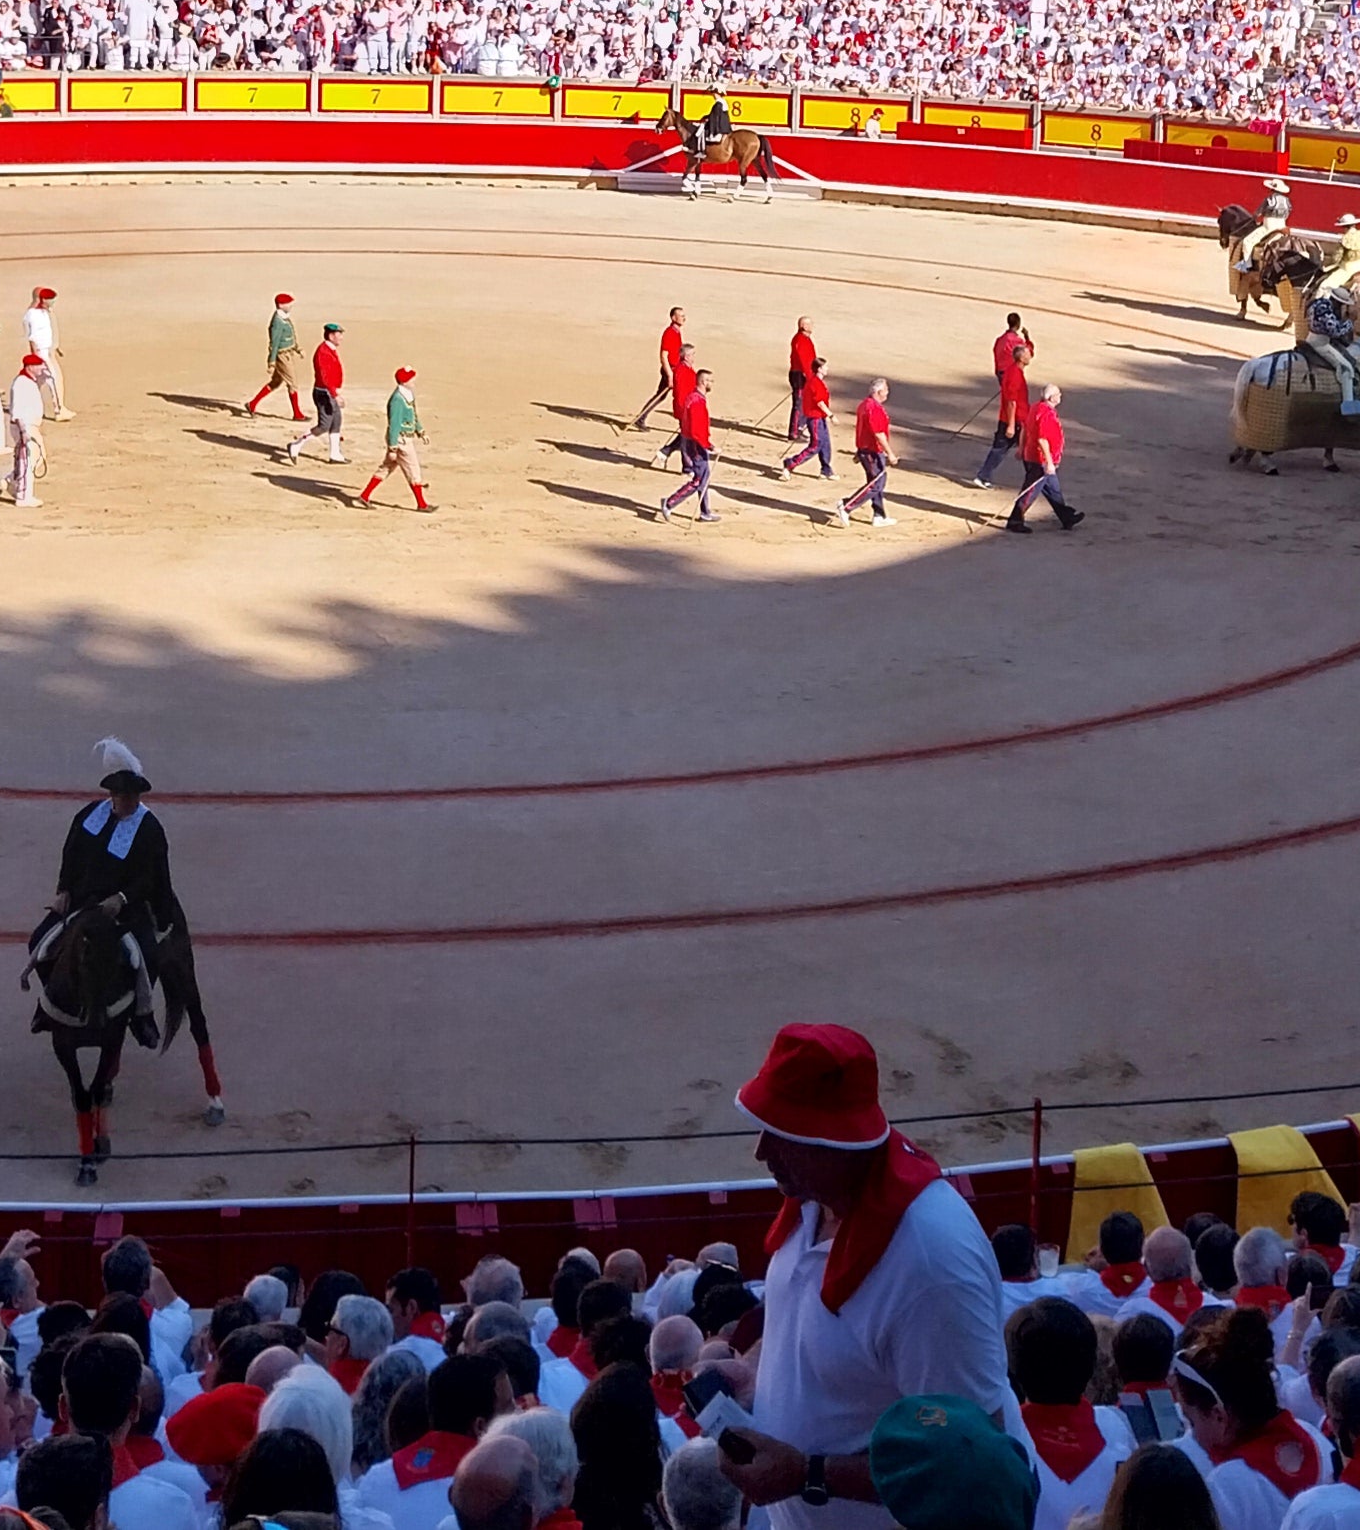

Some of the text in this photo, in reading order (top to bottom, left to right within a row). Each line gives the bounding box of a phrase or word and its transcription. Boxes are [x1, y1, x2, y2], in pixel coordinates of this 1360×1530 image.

[123, 87, 133, 103] 7
[247, 87, 258, 103] 7
[371, 88, 381, 104] 7
[493, 91, 503, 107] 7
[612, 95, 622, 110] 7
[732, 101, 742, 117] 8
[851, 107, 861, 124] 8
[971, 115, 981, 128] 8
[1091, 123, 1102, 141] 8
[1336, 146, 1348, 165] 9
